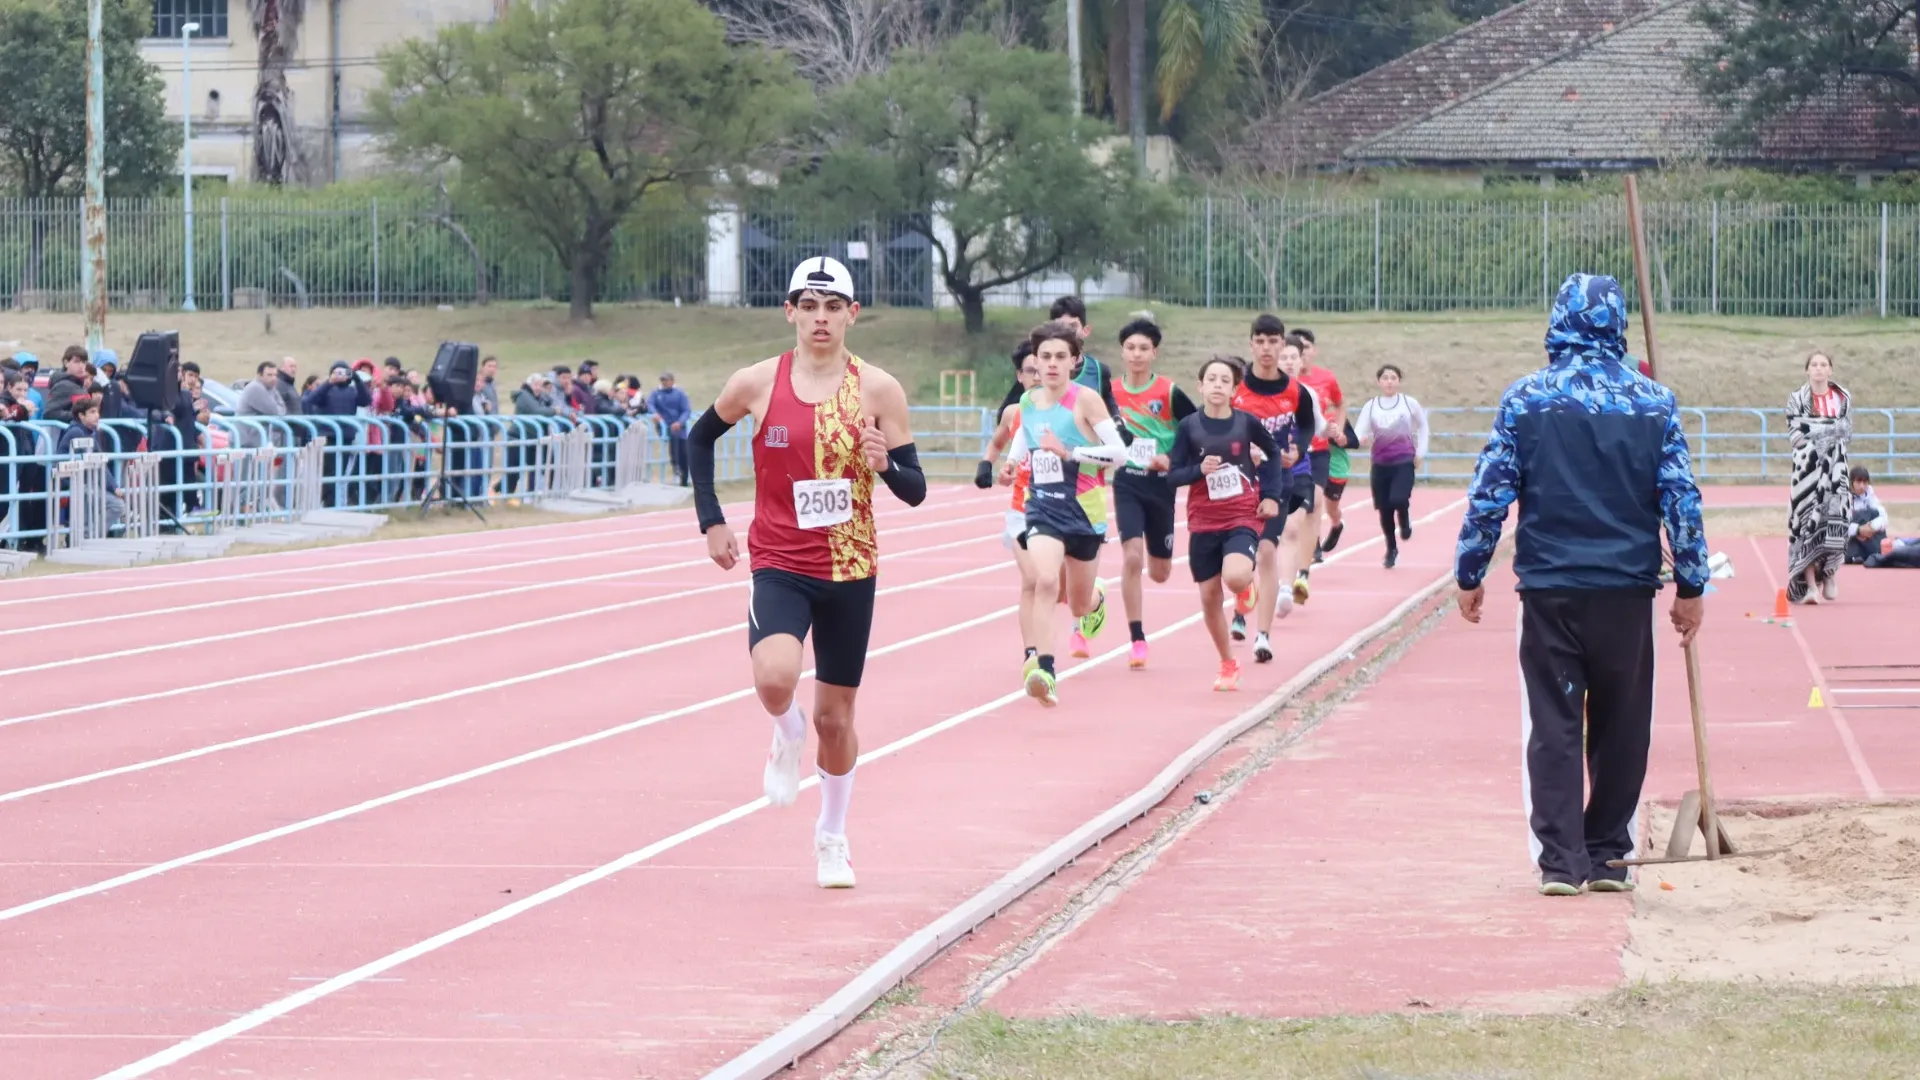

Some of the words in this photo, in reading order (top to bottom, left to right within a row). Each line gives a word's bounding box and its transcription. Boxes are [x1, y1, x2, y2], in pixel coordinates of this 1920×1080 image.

[1034, 456, 1059, 474] 2508
[1209, 473, 1238, 491] 2493
[798, 489, 848, 515] 2503
